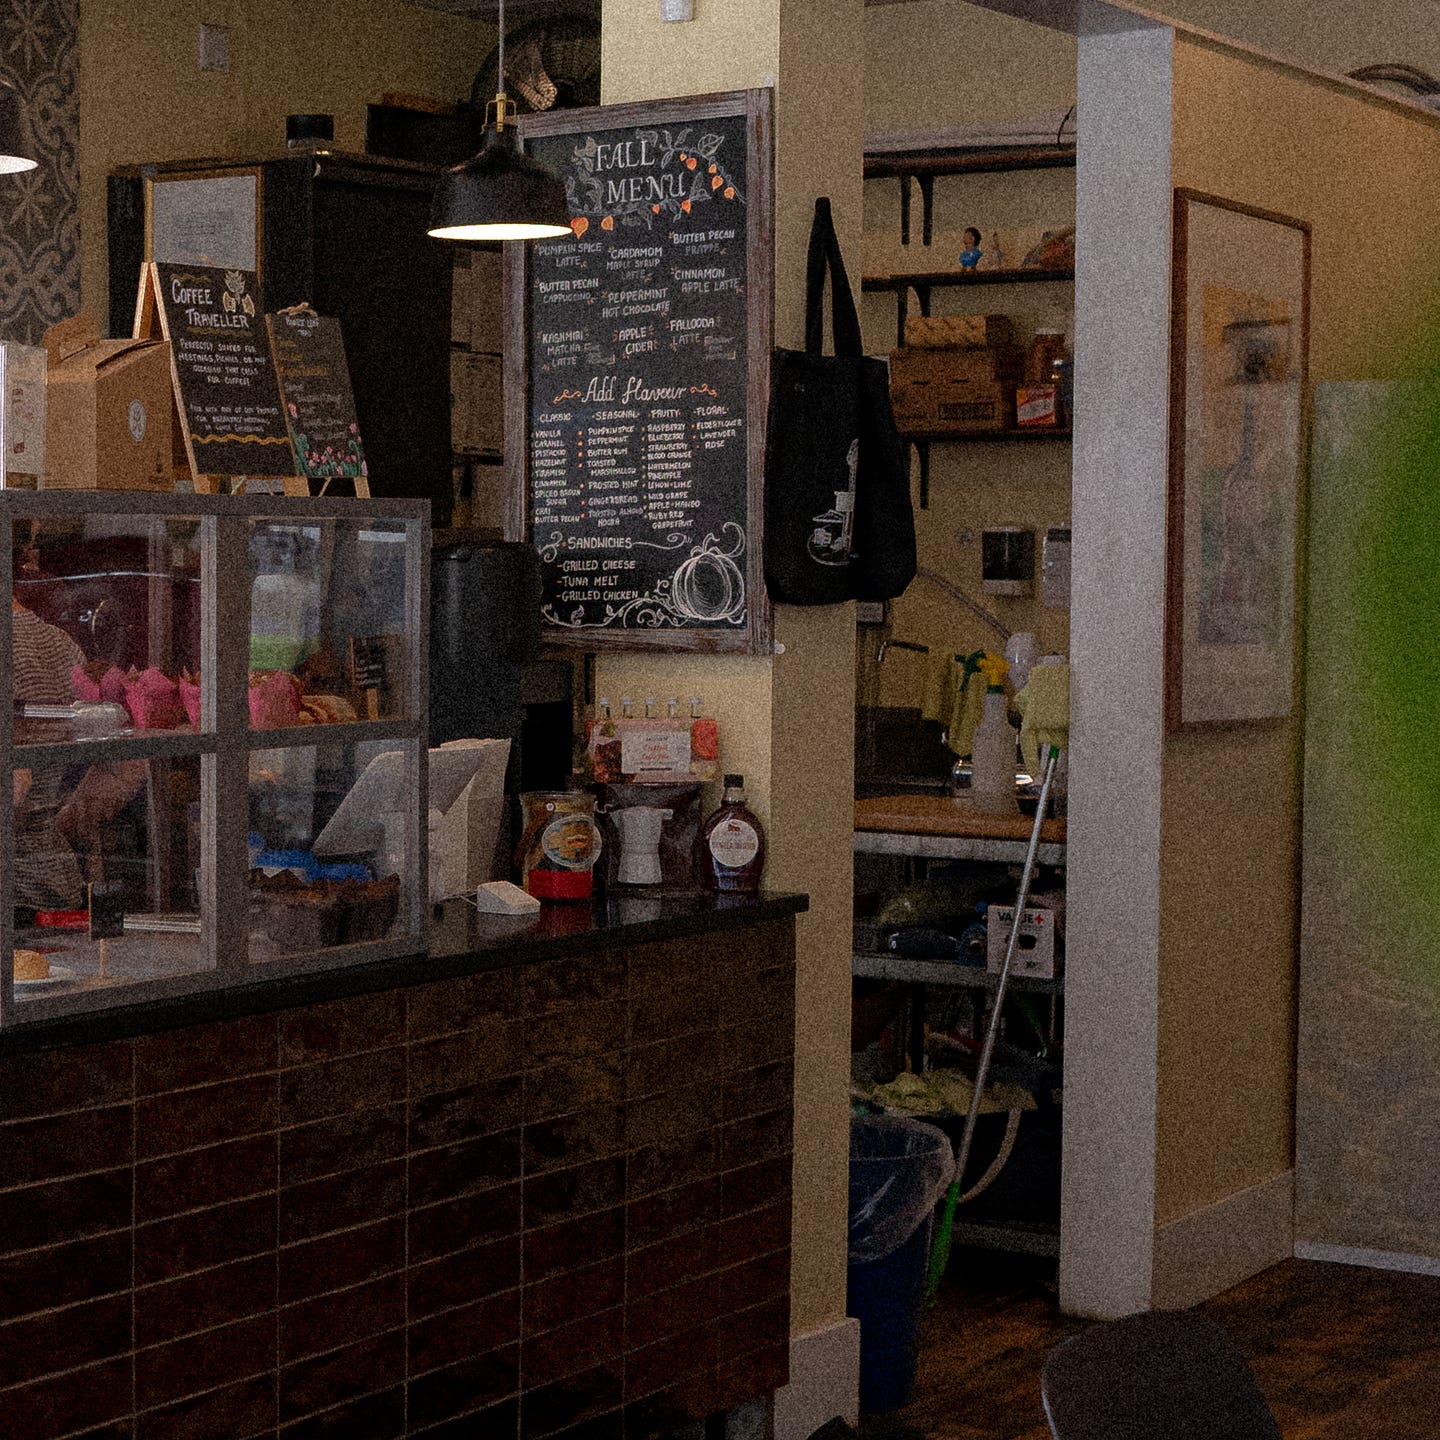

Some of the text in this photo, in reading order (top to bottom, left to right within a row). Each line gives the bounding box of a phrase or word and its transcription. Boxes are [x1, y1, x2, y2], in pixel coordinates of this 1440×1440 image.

[596, 140, 656, 171] FALL
[607, 172, 686, 204] MENU
[673, 230, 735, 244] BUTTER PECAN
[539, 243, 602, 256] PUMPKIN SPICE
[611, 247, 662, 259] CARDAMOM
[556, 256, 581, 267] LATTE
[634, 258, 660, 268] SYRUP
[675, 268, 725, 280] CINNAMON
[539, 278, 599, 293] BUTTER PECAN
[681, 279, 741, 293] APPLE LATTE
[172, 279, 213, 305] COFFEE
[608, 288, 668, 303] PEPPERMINT
[543, 293, 591, 304] CAPPUCCINO
[603, 301, 670, 318] HOT CHOCOLATE
[185, 308, 250, 328] TRAVELLER
[542, 330, 583, 344] KASHMIRI
[618, 328, 647, 341] APPLE
[673, 334, 700, 345] LATTE
[547, 342, 581, 355] MATCHA
[625, 341, 653, 354] CIDER
[551, 355, 577, 366] LATTE
[581, 376, 616, 403] Add
[540, 406, 728, 423] CLASSIC SEASONAL FRUITY FLORAL
[647, 423, 686, 432] RASPBERRY
[696, 418, 742, 430] ELDERFLOWER
[535, 430, 561, 439] VANILLA
[647, 433, 685, 442] BLUEBERRY
[699, 429, 736, 440] LAVENDER
[535, 440, 564, 449] CARAMEL
[648, 443, 688, 452] STRAWBERRY
[705, 440, 725, 449] ROSE
[587, 448, 612, 457] BUTTER
[648, 461, 691, 471] WATERMELON
[588, 480, 639, 490] FROSTED MINT
[588, 495, 638, 506] GINGERBREAD
[567, 537, 633, 550] SANDWICHES
[562, 559, 636, 571] GRILLED CHEESE
[561, 575, 619, 587] TUNA MELT
[561, 590, 639, 602] GRILLED CHICKEN
